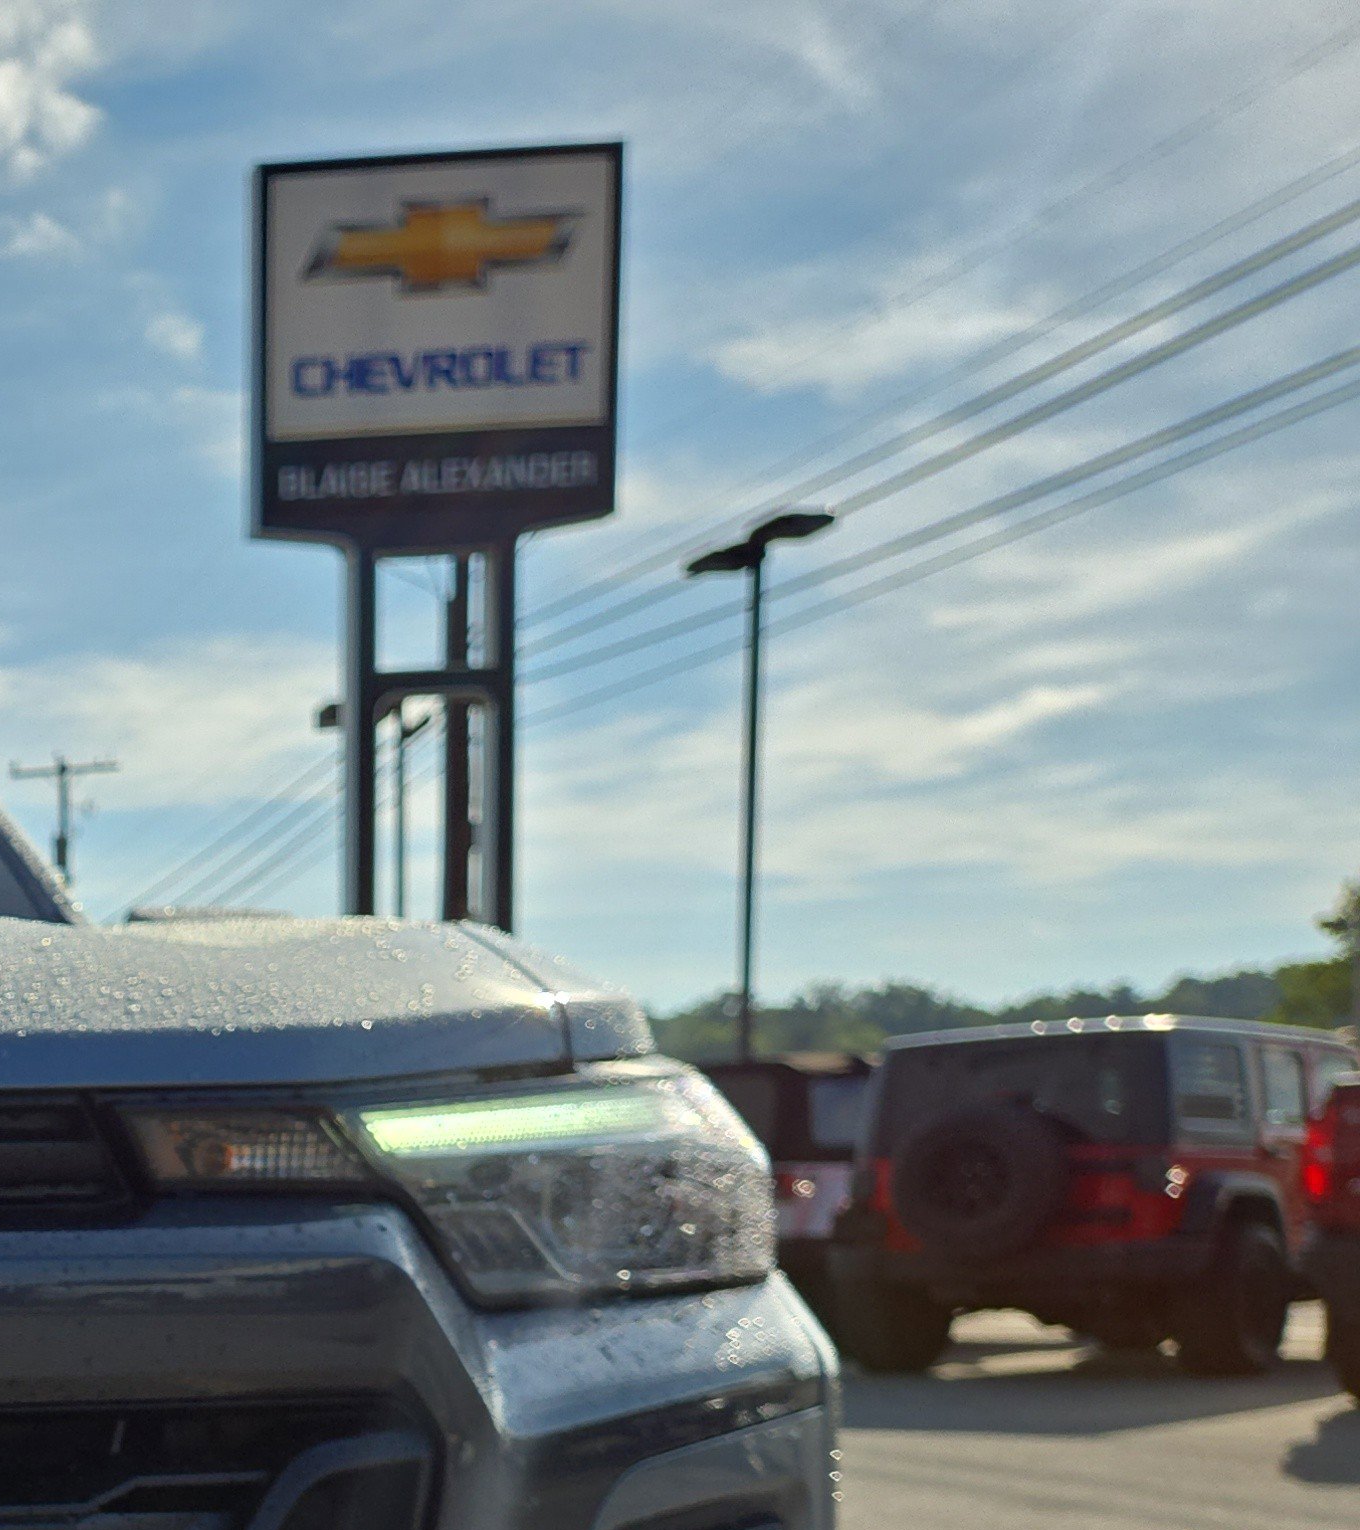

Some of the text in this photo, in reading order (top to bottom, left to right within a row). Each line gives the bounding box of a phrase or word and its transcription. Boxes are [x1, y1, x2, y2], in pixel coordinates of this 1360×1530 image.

[291, 341, 588, 397] CHEVROLET
[278, 450, 597, 500] BLAISE ALEXANDER
